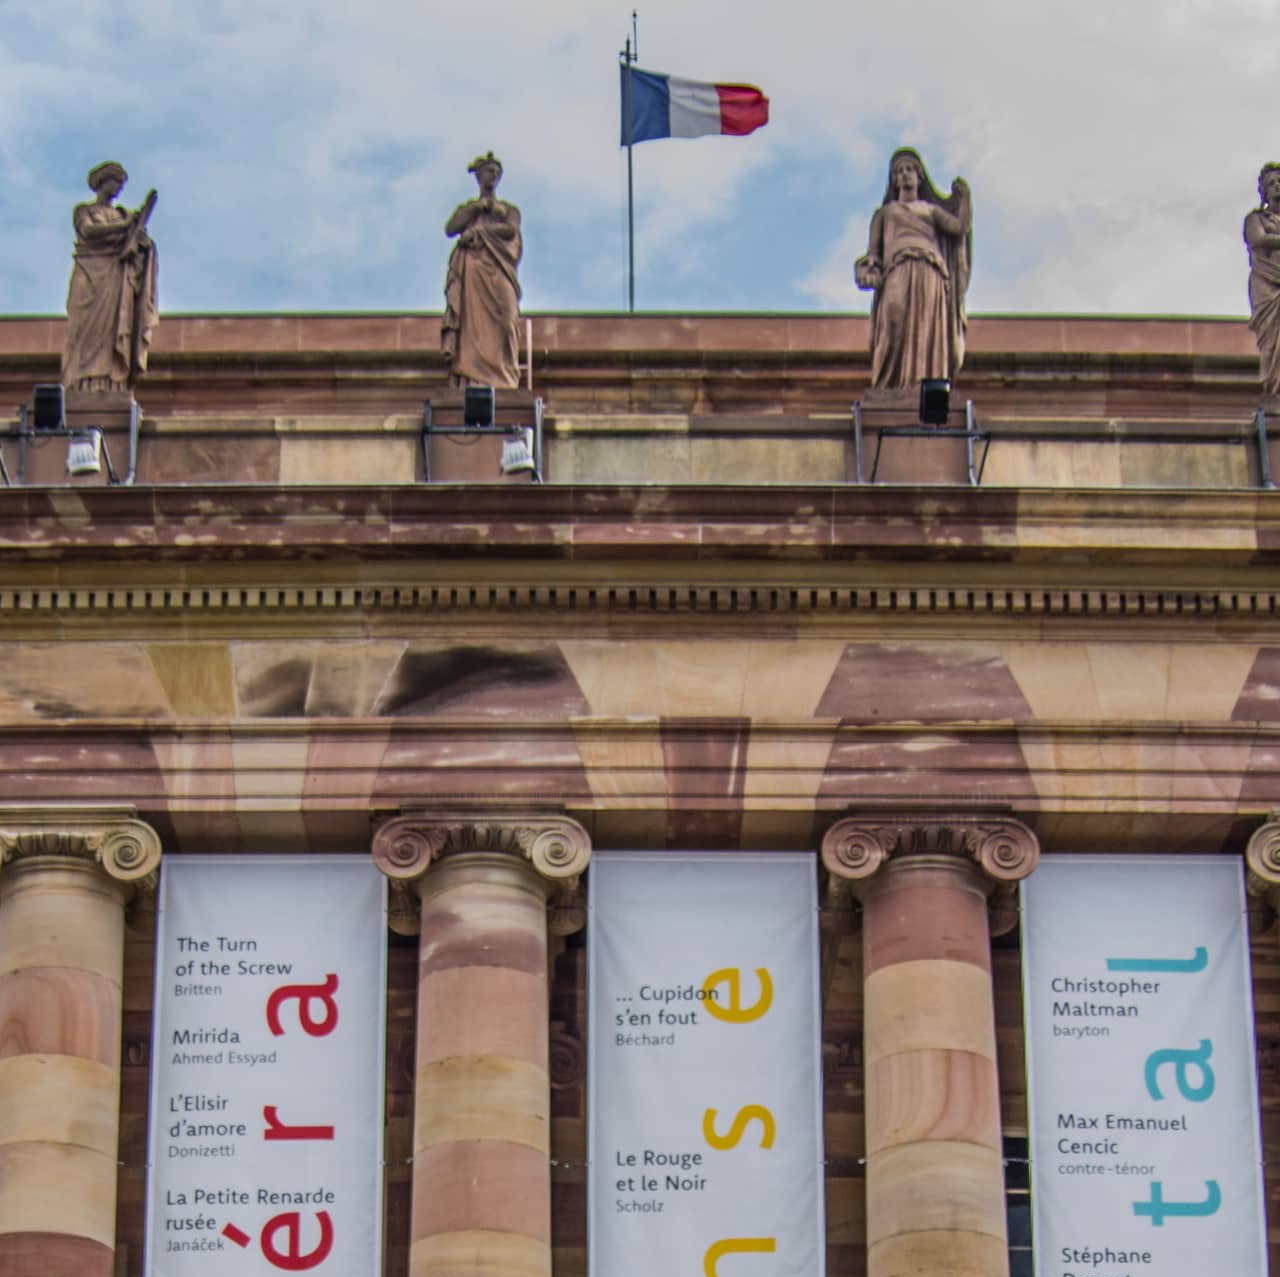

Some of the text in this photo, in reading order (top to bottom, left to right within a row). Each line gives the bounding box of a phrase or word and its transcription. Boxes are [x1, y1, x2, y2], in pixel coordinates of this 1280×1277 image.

[176, 937, 257, 952] The Turn
[175, 960, 293, 977] of the Screw
[174, 984, 222, 997] Britten
[639, 985, 719, 1005] Cupidon
[1051, 977, 1160, 997] Christopher
[658, 1009, 698, 1025] fout
[1052, 1002, 1138, 1017] Maltman
[173, 1028, 240, 1045] Mririda
[616, 1033, 675, 1046] Béchard
[1053, 1024, 1110, 1040] baryton
[172, 1050, 277, 1068] Ahmed Essyad
[1057, 1114, 1187, 1131] Max Emanuel
[168, 1144, 235, 1159] Donizetti
[1057, 1138, 1119, 1155] Cencic
[617, 1151, 703, 1170] Le Rouge
[1058, 1161, 1155, 1175] contre-ténor
[616, 1176, 706, 1192] et le Noir
[167, 1189, 335, 1206] La Petite Renarde
[616, 1199, 664, 1213] Scholz
[166, 1215, 216, 1232] rusée
[166, 1237, 225, 1253] Janáček
[1062, 1247, 1152, 1267] Stéphane
